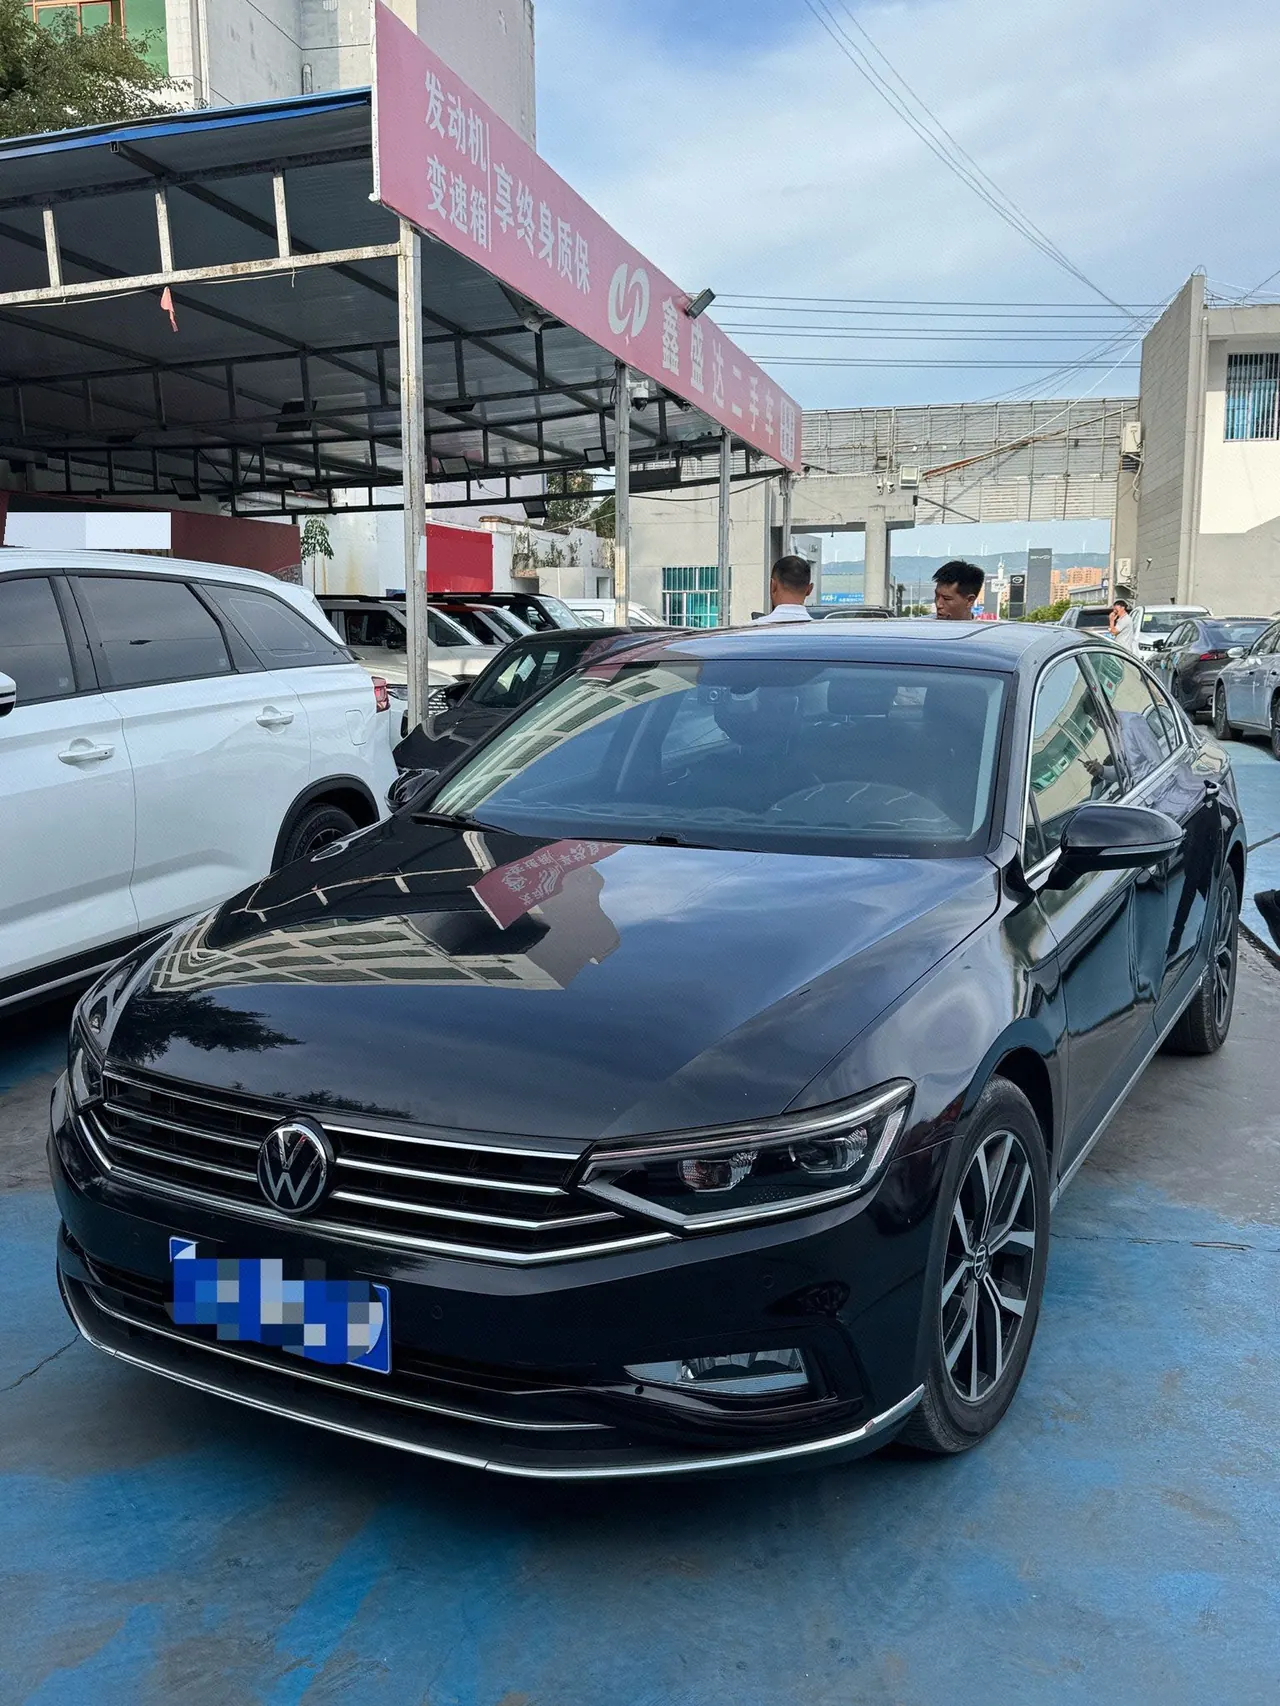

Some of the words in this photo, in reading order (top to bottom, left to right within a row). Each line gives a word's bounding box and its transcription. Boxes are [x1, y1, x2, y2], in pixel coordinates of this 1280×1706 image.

[425, 71, 487, 172] 发动机
[427, 155, 487, 249] 变速箱
[493, 163, 591, 294] 享终身质保
[662, 296, 774, 444] 鑫盛达二手车
